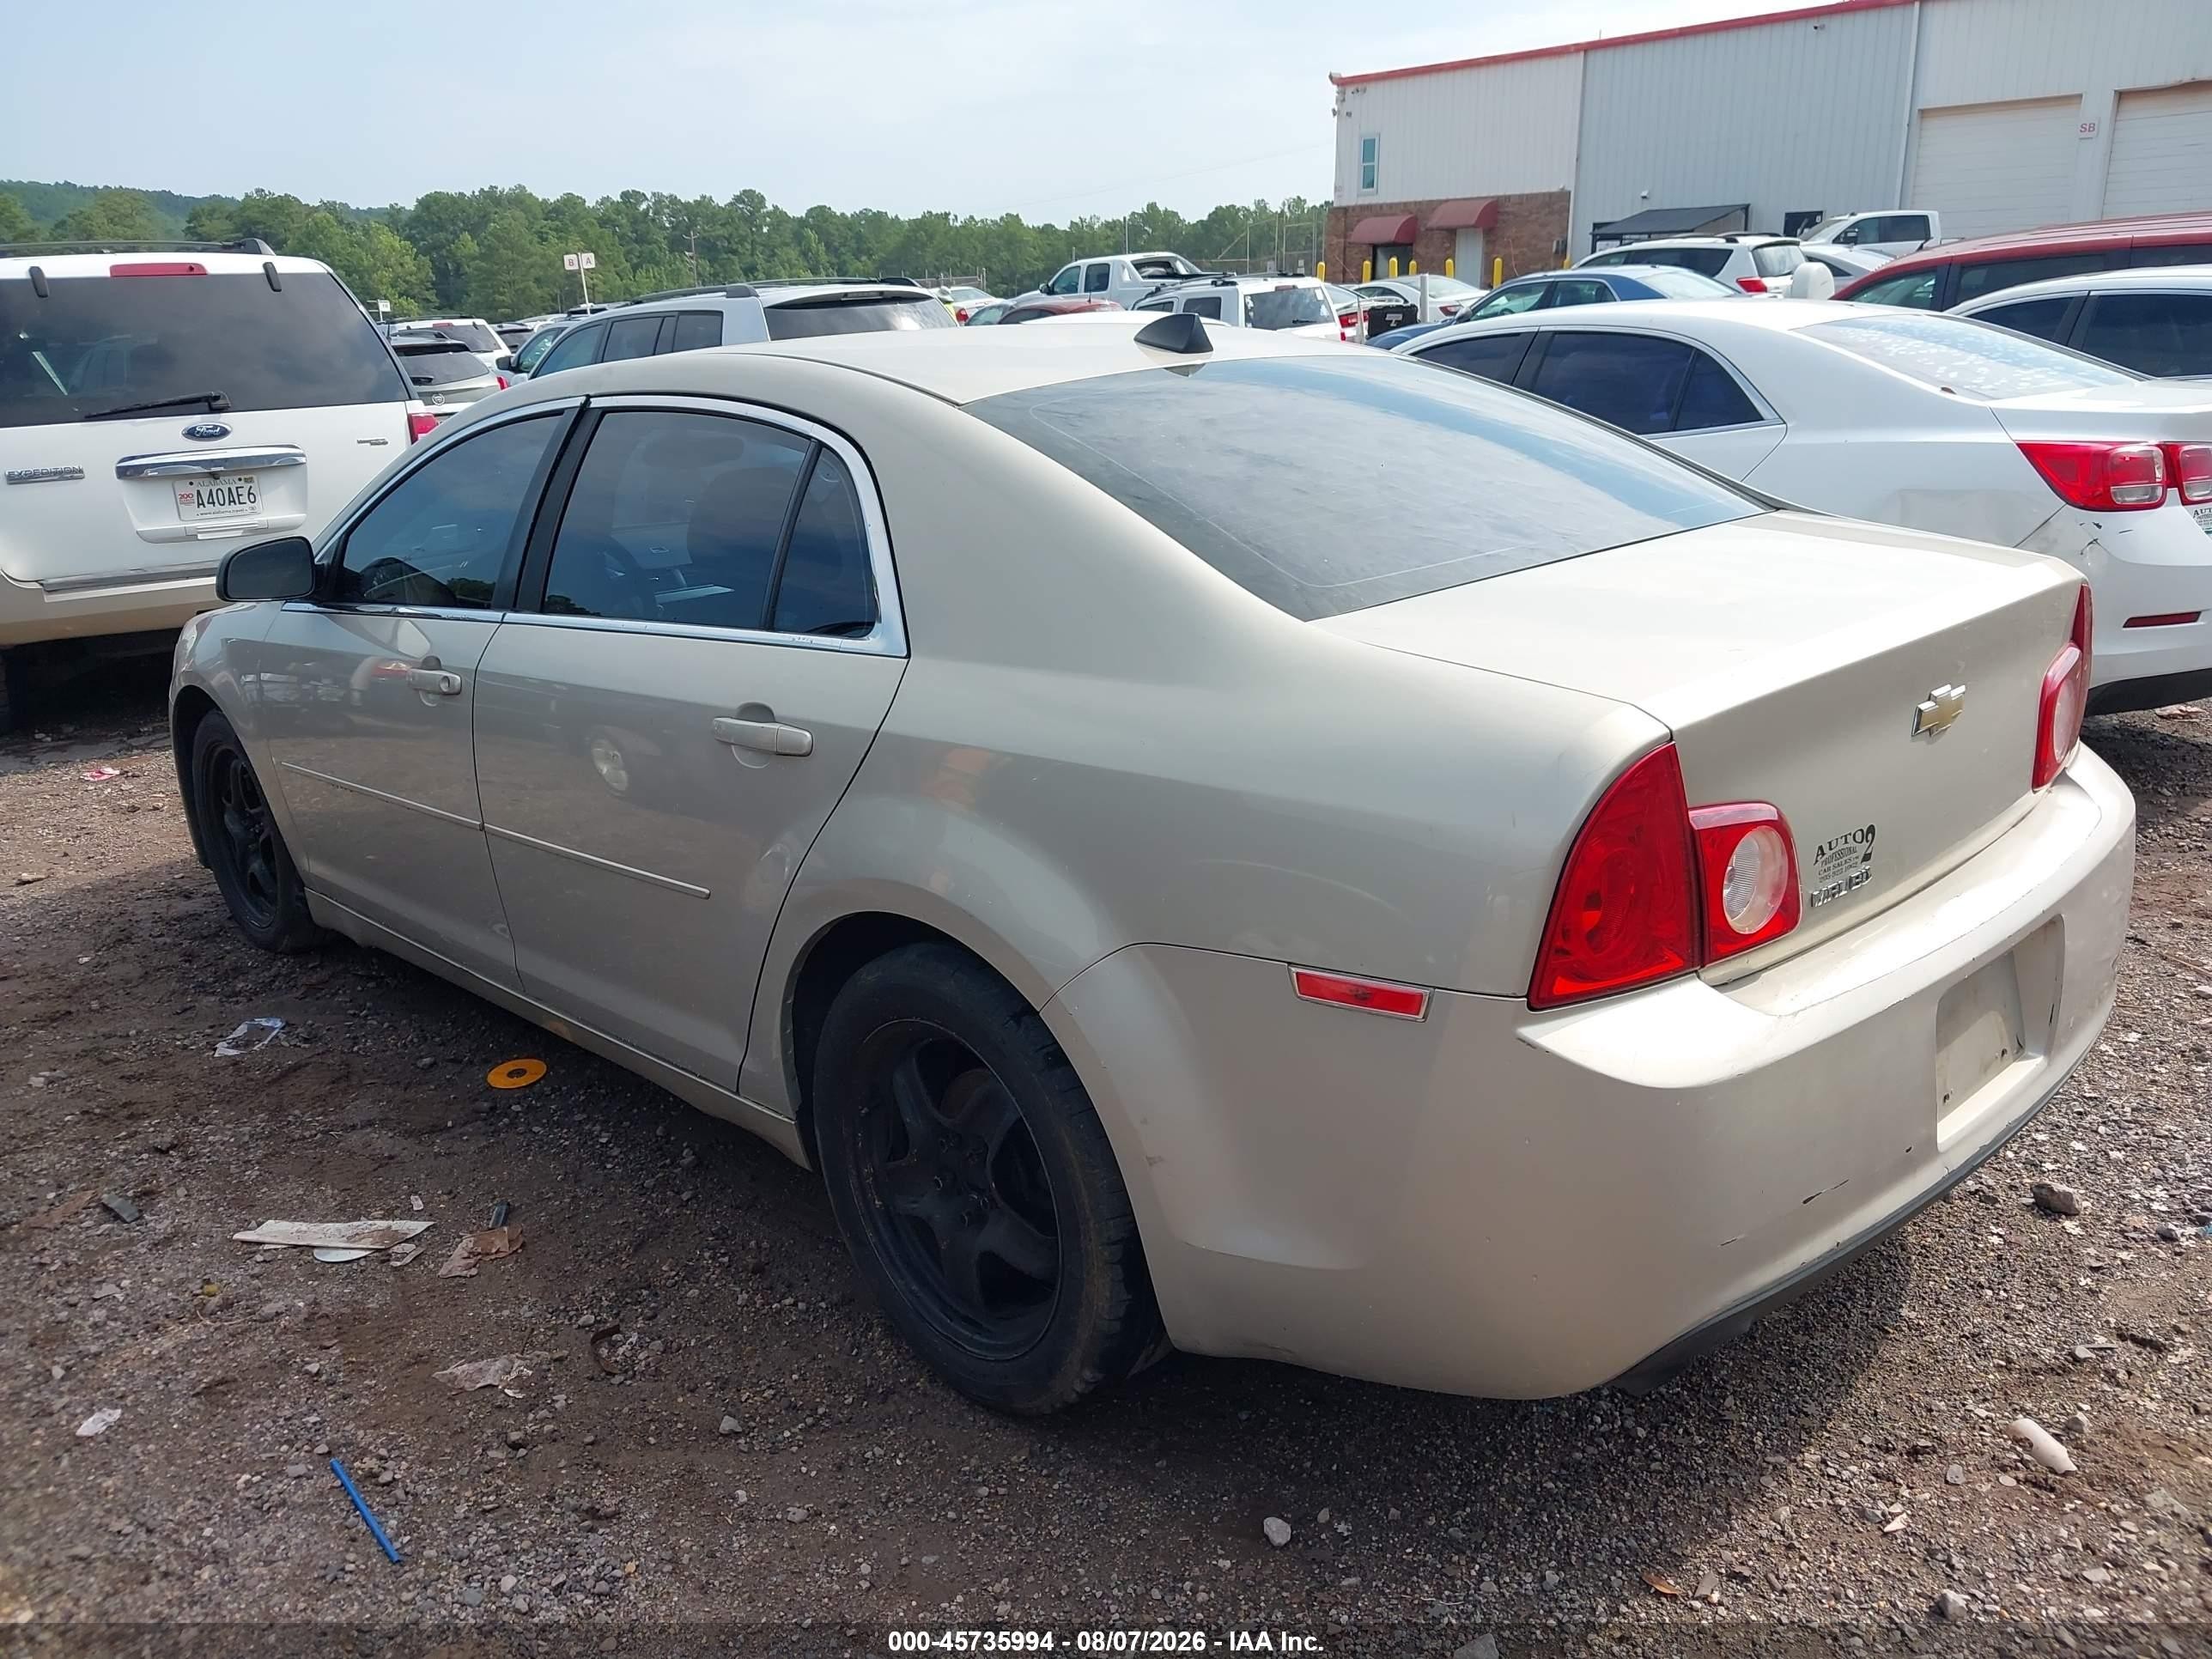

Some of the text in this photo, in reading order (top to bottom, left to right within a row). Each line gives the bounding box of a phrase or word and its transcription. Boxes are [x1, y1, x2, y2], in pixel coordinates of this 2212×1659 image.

[2080, 123, 2095, 133] SB
[195, 425, 220, 436] Ford
[5, 466, 84, 479] EXPEDITION
[197, 478, 237, 487] ALABAMA
[197, 485, 256, 508] A40AE6
[1814, 829, 1864, 866] AUTO
[1821, 846, 1857, 867] PROFESSIONAL
[1819, 866, 1831, 875] CAR
[1832, 858, 1852, 870] SALES
[1811, 865, 1872, 907] MALIBU
